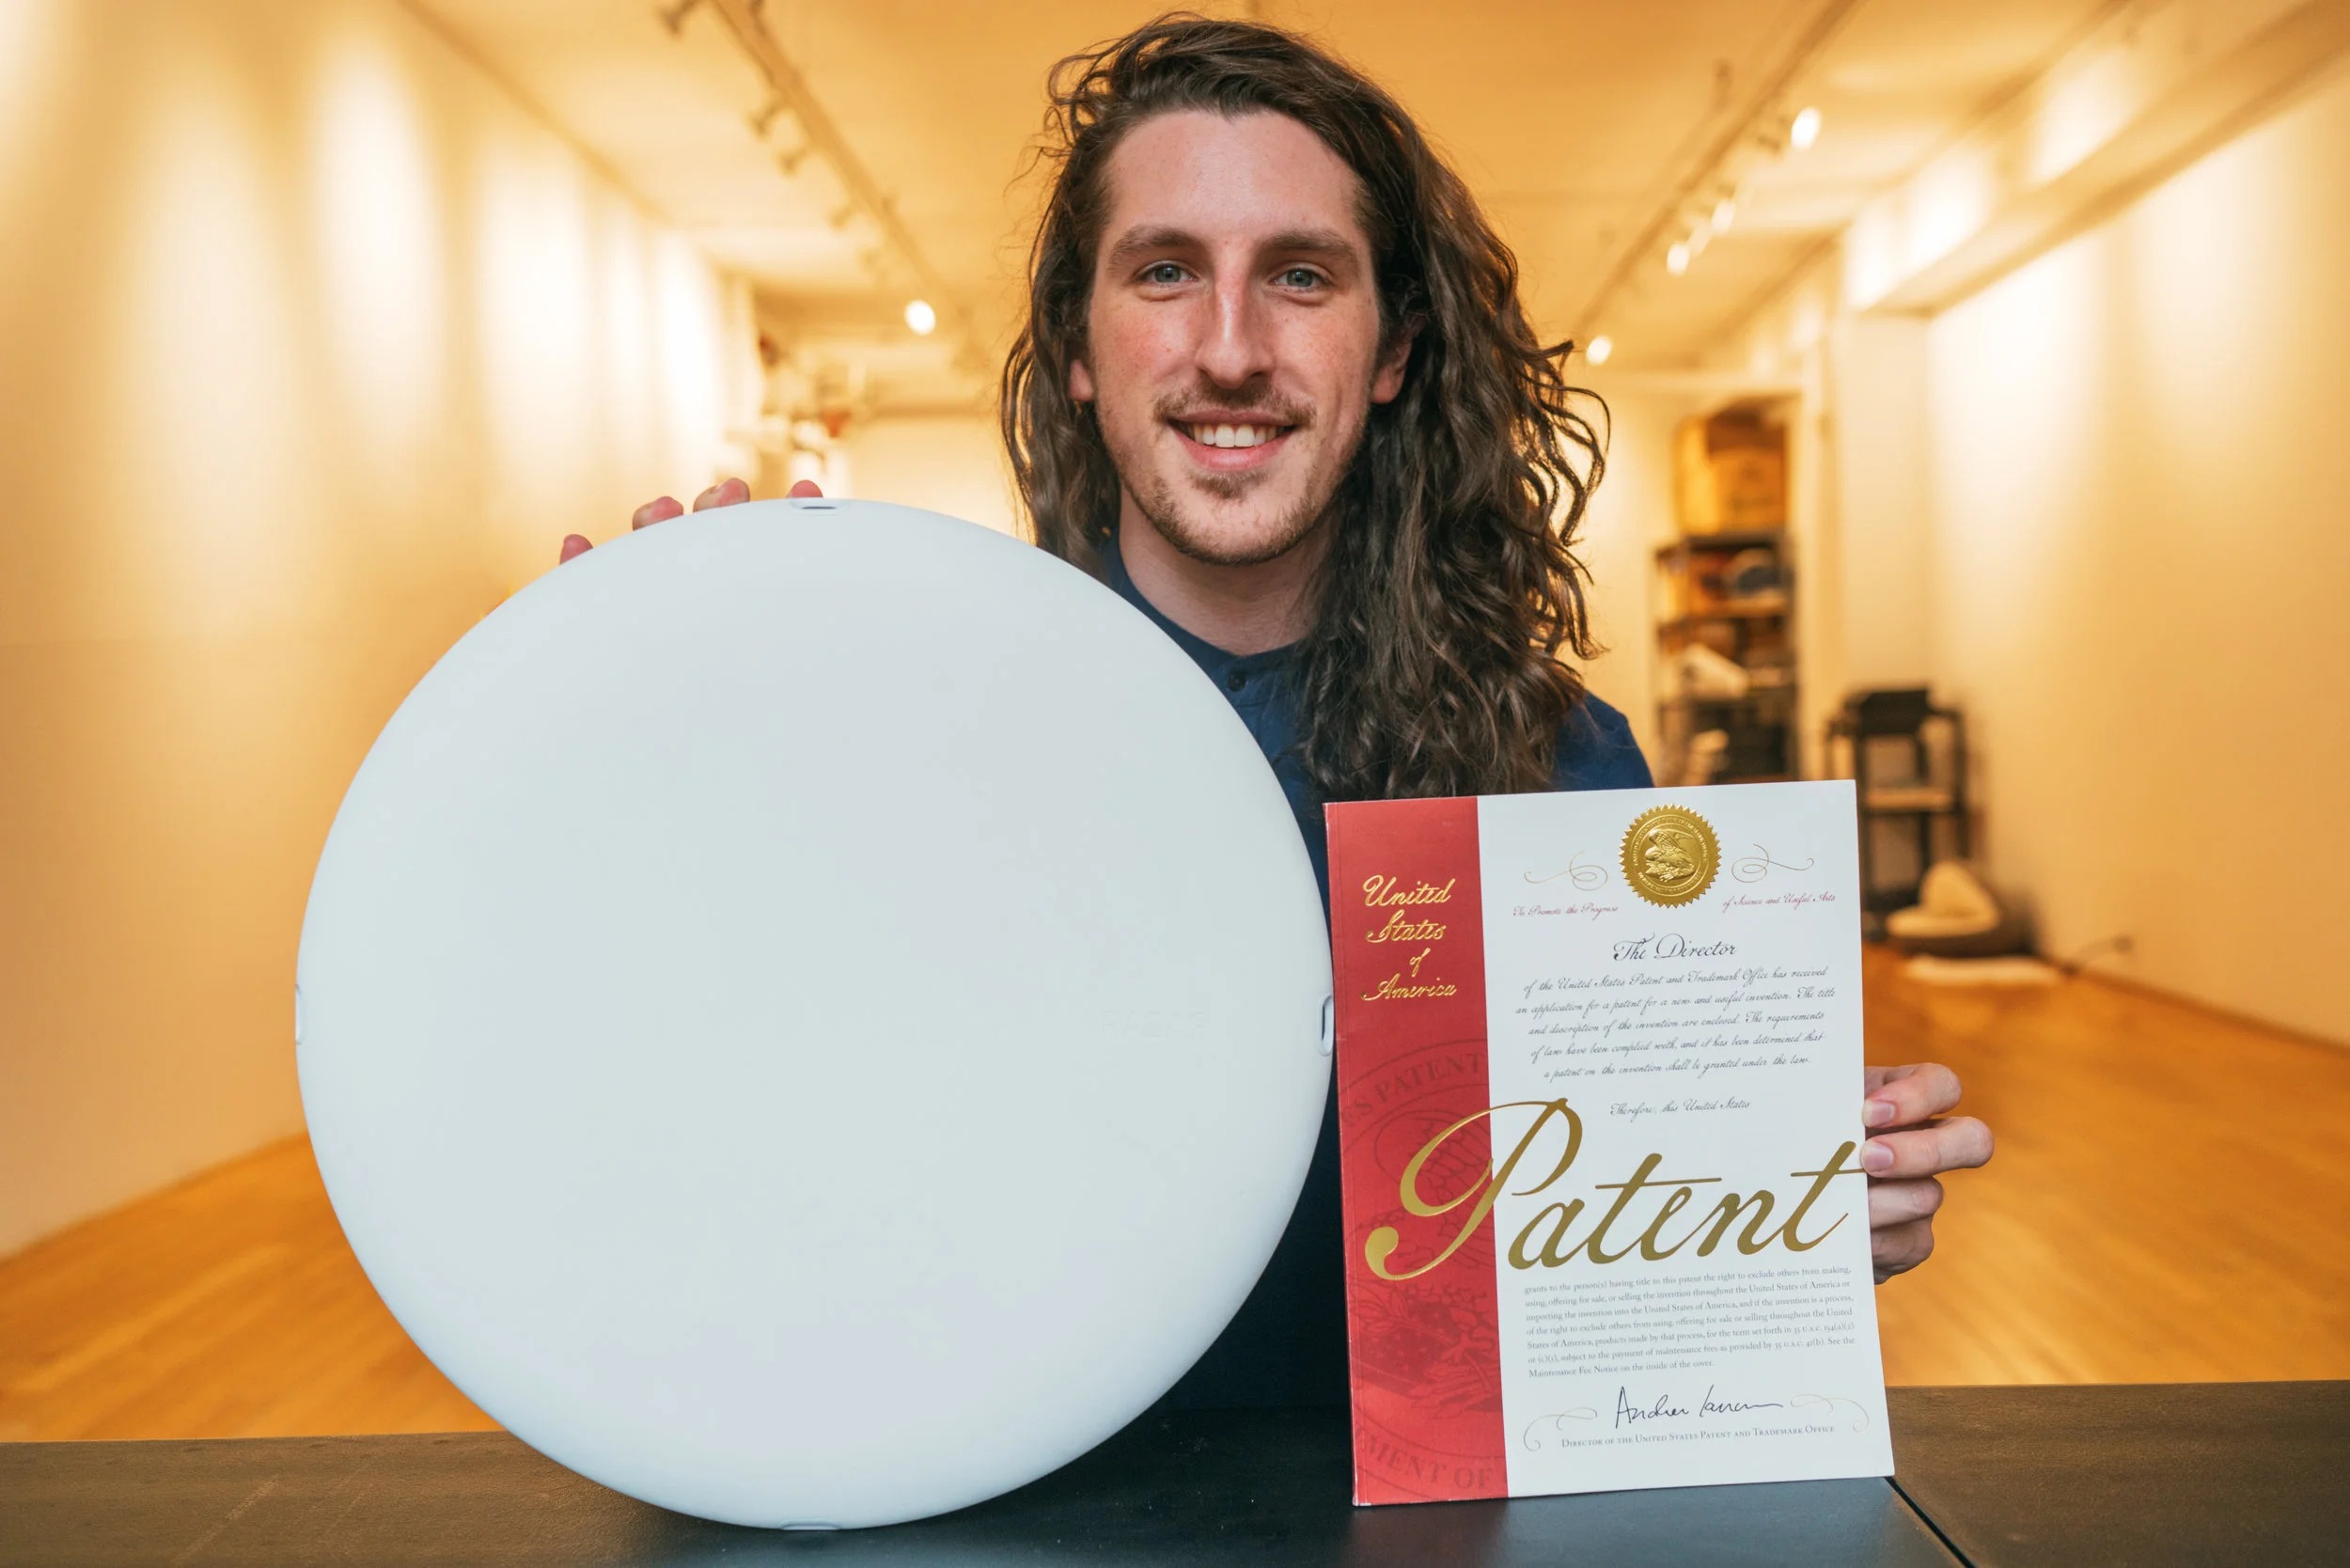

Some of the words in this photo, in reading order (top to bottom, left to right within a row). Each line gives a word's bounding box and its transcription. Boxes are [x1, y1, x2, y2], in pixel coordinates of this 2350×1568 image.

[1362, 874, 1456, 907] United
[1365, 908, 1447, 944] States
[1409, 947, 1431, 978] of
[1613, 931, 1655, 962] The
[1653, 933, 1737, 959] Director
[1360, 972, 1457, 1001] America
[1522, 979, 1538, 999] of
[1538, 977, 1553, 992] the
[1557, 976, 1594, 990] United
[1592, 974, 1629, 988] States
[1628, 971, 1664, 986] Patent
[1665, 972, 1684, 983] and
[1686, 967, 1742, 982] Trademark
[1741, 965, 1768, 989] Office
[1770, 965, 1788, 979] has
[1790, 965, 1828, 978] received
[1530, 1000, 1583, 1020] application
[1581, 998, 1600, 1019] for
[1608, 997, 1641, 1014] patent
[1638, 996, 1657, 1016] for
[1659, 998, 1668, 1007] a
[1694, 994, 1715, 1005] and
[1714, 989, 1746, 1011] useful
[1795, 985, 1814, 999] The
[1816, 986, 1836, 999] title
[1527, 1024, 1548, 1036] and
[1548, 1022, 1599, 1039] description
[1602, 1018, 1617, 1039] of
[1616, 1017, 1632, 1030] the
[1634, 1017, 1679, 1029] invention
[1744, 1010, 1762, 1024] The
[1765, 1010, 1825, 1029] requirements
[1529, 1043, 1545, 1064] of
[1543, 1044, 1562, 1057] law
[1564, 1042, 1587, 1055] have
[1589, 1042, 1608, 1053] been
[1610, 1040, 1653, 1058] complied
[1679, 1038, 1700, 1049] and
[1700, 1037, 1713, 1047] it
[1711, 1033, 1729, 1047] has
[1730, 1033, 1749, 1046] been
[1751, 1031, 1802, 1044] determined
[1802, 1028, 1825, 1042] that
[1374, 1053, 1483, 1103] PATENT
[1548, 1067, 1585, 1083] patent
[1600, 1061, 1616, 1074] the
[1618, 1061, 1662, 1074] invention
[1664, 1058, 1691, 1071] shall
[1691, 1058, 1700, 1070] be
[1697, 1057, 1741, 1079] granted
[1740, 1056, 1767, 1067] under
[1772, 1052, 1787, 1065] the
[1660, 1099, 1679, 1112] this
[1682, 1097, 1719, 1112] United
[1719, 1095, 1751, 1109] States
[1364, 1097, 1867, 1281] Patent
[1560, 1437, 1603, 1448] DIRECTOR
[1634, 1433, 1667, 1443] UNITED
[1700, 1430, 1731, 1439] PATENT
[1732, 1429, 1751, 1437] AND
[1751, 1426, 1803, 1436] TRADEMARK
[1804, 1423, 1834, 1434] OFFICE
